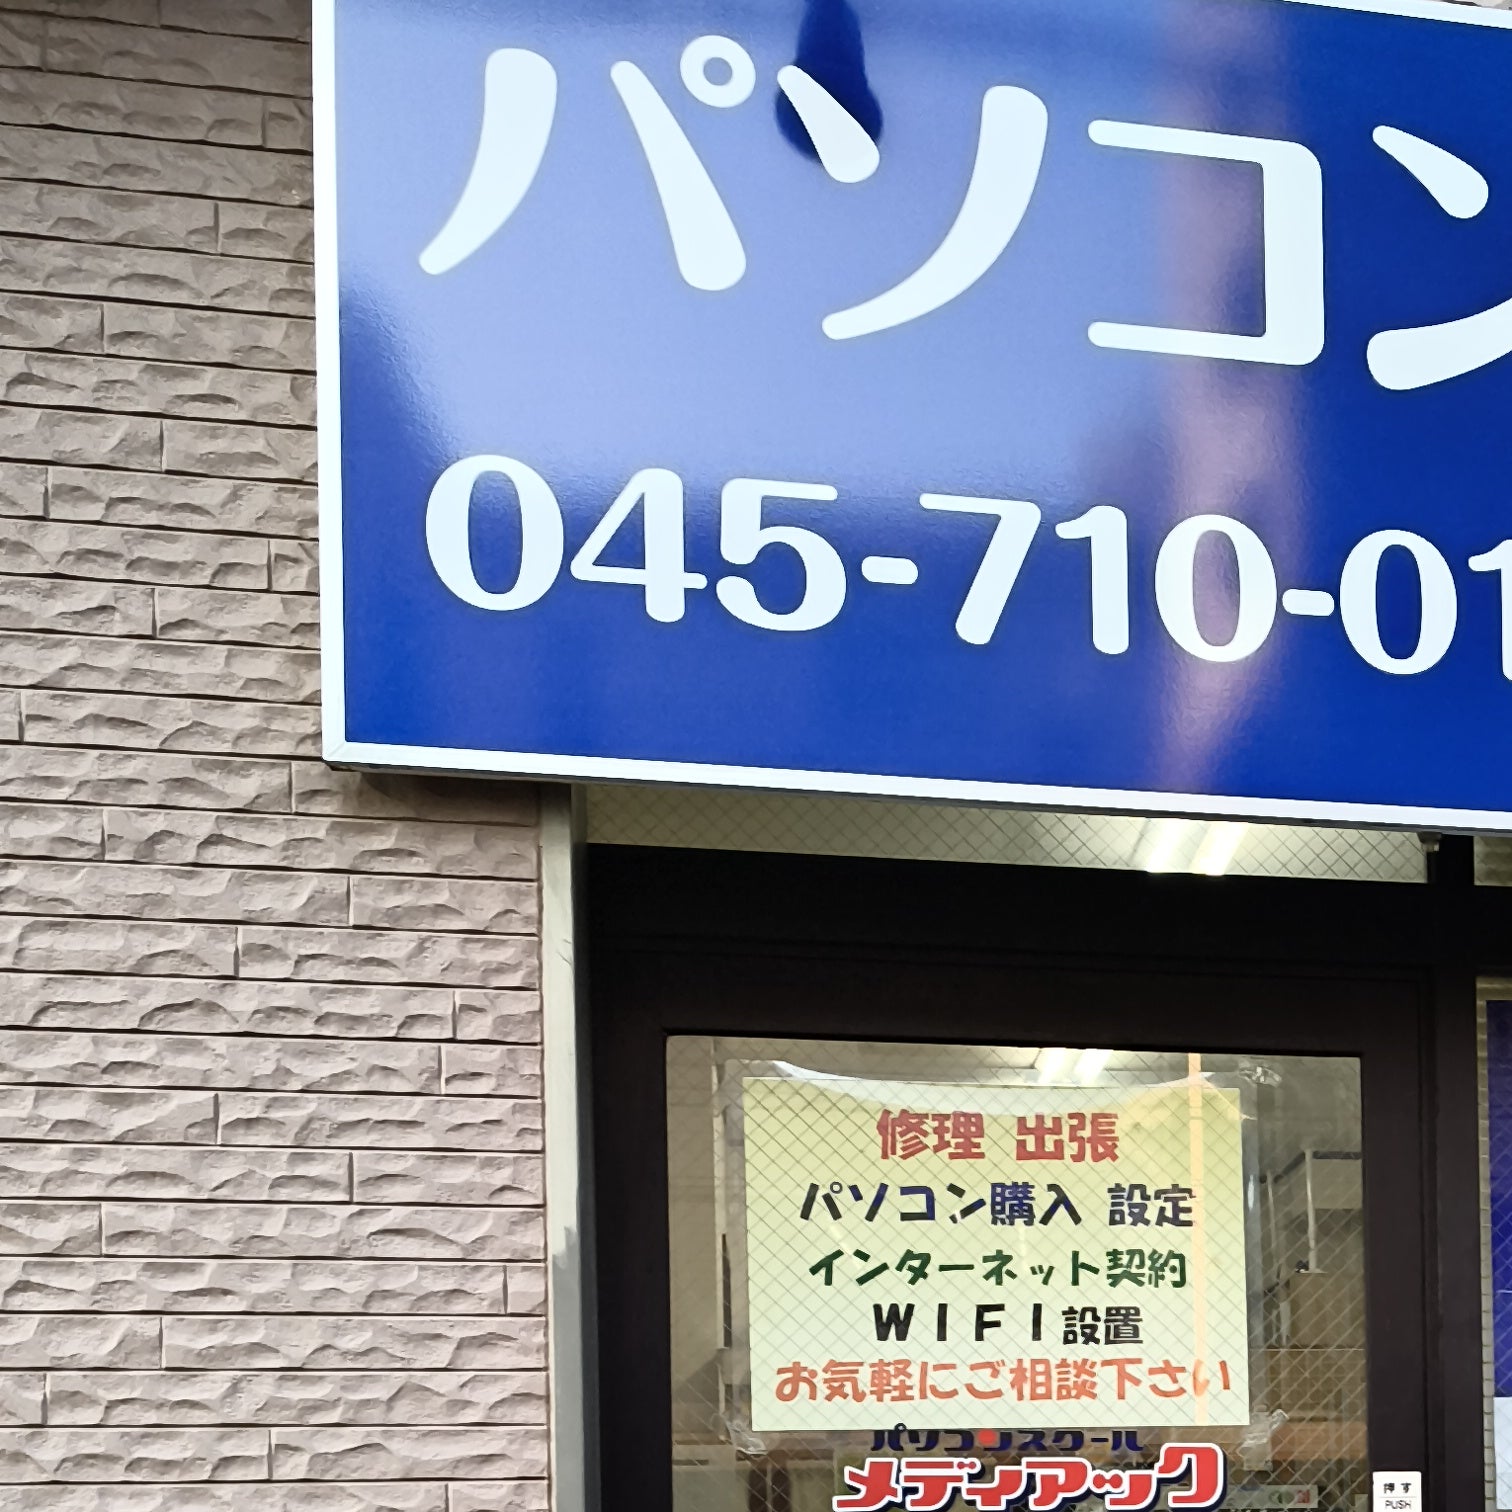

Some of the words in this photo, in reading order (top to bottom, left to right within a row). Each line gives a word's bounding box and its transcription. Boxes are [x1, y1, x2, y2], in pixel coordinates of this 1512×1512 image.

[877, 1110, 986, 1162] 修理
[1016, 1112, 1120, 1164] 出張
[799, 1181, 1084, 1228] パソコン購入
[1108, 1183, 1195, 1228] 設定
[808, 1248, 1187, 1289] インターネット契約
[775, 1358, 1232, 1403] お気軽にご相談下さい
[871, 1422, 1145, 1452] パソコンスクール
